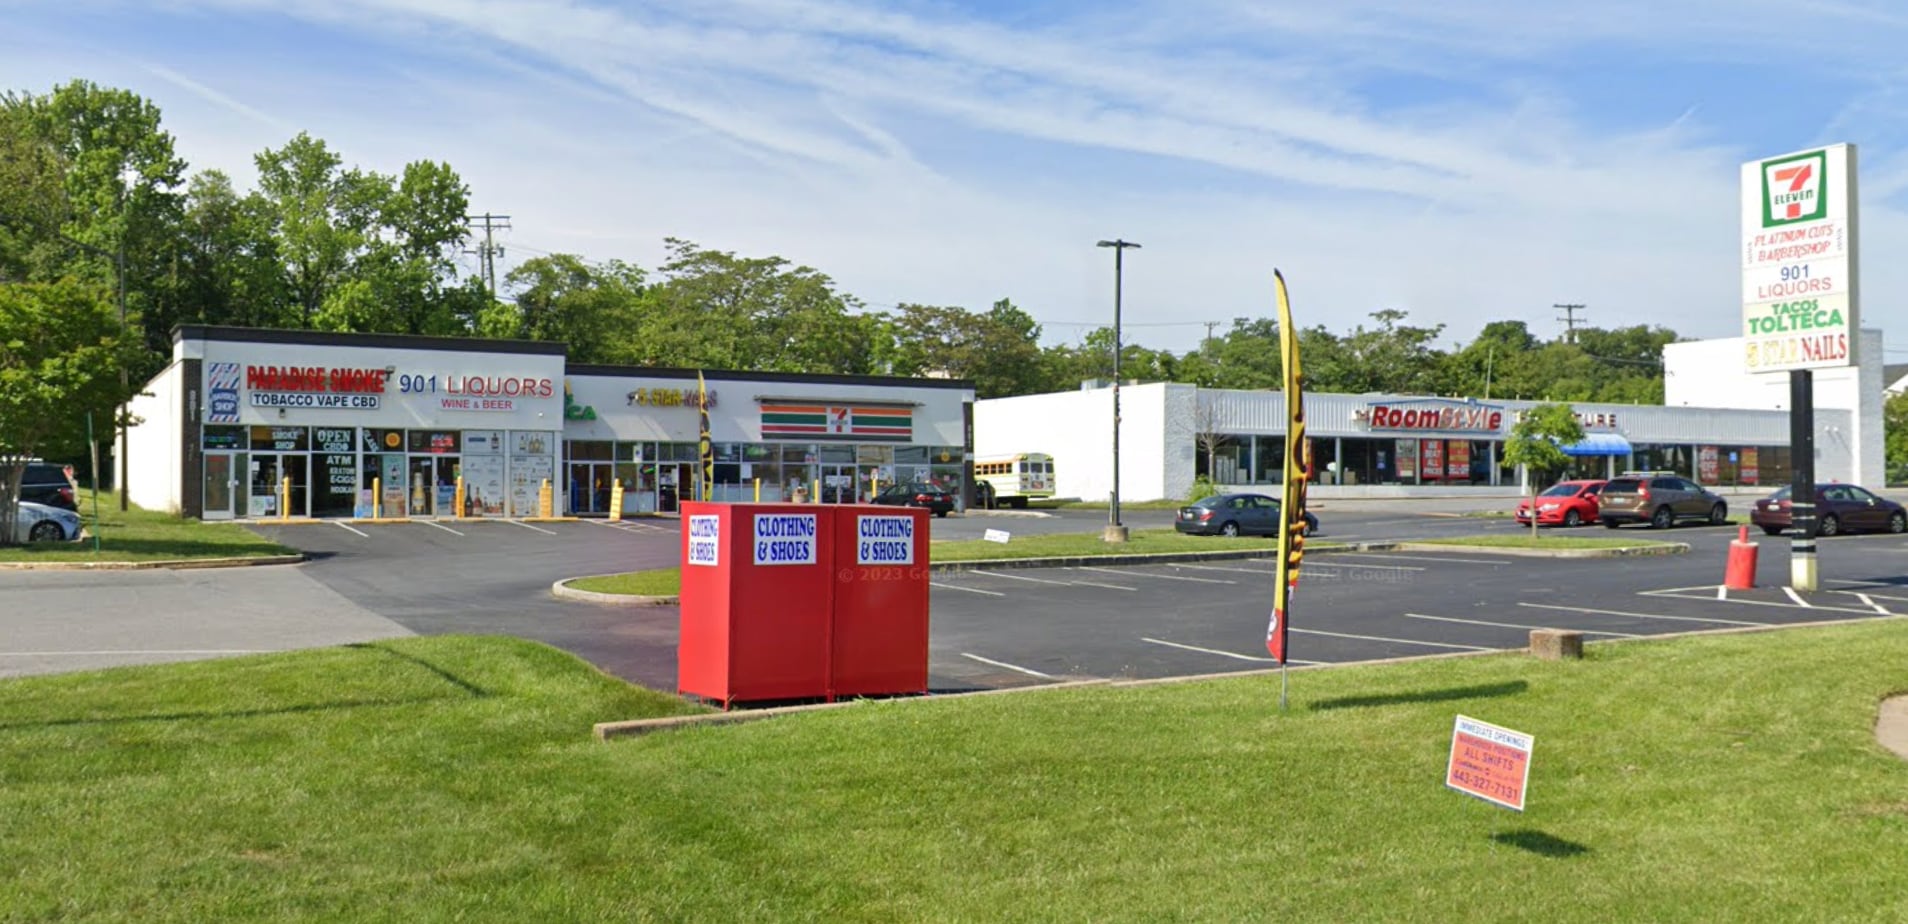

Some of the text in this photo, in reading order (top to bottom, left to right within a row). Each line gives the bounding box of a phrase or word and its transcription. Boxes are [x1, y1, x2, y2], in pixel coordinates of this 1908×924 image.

[1774, 164, 1812, 218] 7
[1754, 224, 1835, 247] PLATINUM CUTS
[1758, 241, 1832, 261] BARBERSHOP
[1780, 264, 1809, 281] 901
[1758, 277, 1832, 298] LIQUORS
[1771, 299, 1818, 315] TACOS
[1748, 309, 1844, 334] TOLTECA
[1763, 338, 1799, 365] STAR
[1801, 333, 1847, 362] NAILS
[247, 365, 385, 393] PARADISE SMOKE
[399, 374, 553, 398] 901 LIQUORS
[214, 402, 235, 411] SHOP
[253, 393, 377, 408] TOBACCO VAPE CBD
[441, 398, 513, 410] WINE & BEER
[317, 429, 351, 442] OPEN
[326, 455, 352, 465] ATM
[690, 518, 718, 538] CLOTHING
[757, 516, 815, 538] CLOTHING
[860, 518, 912, 538] CLOTHING
[695, 541, 716, 561] SHOES
[757, 541, 810, 561] & SHOES
[860, 541, 908, 561] & SHOES
[1464, 747, 1480, 761] ALL
[1482, 752, 1514, 771] SHIFTS
[1453, 769, 1518, 800] 443-327-7131
